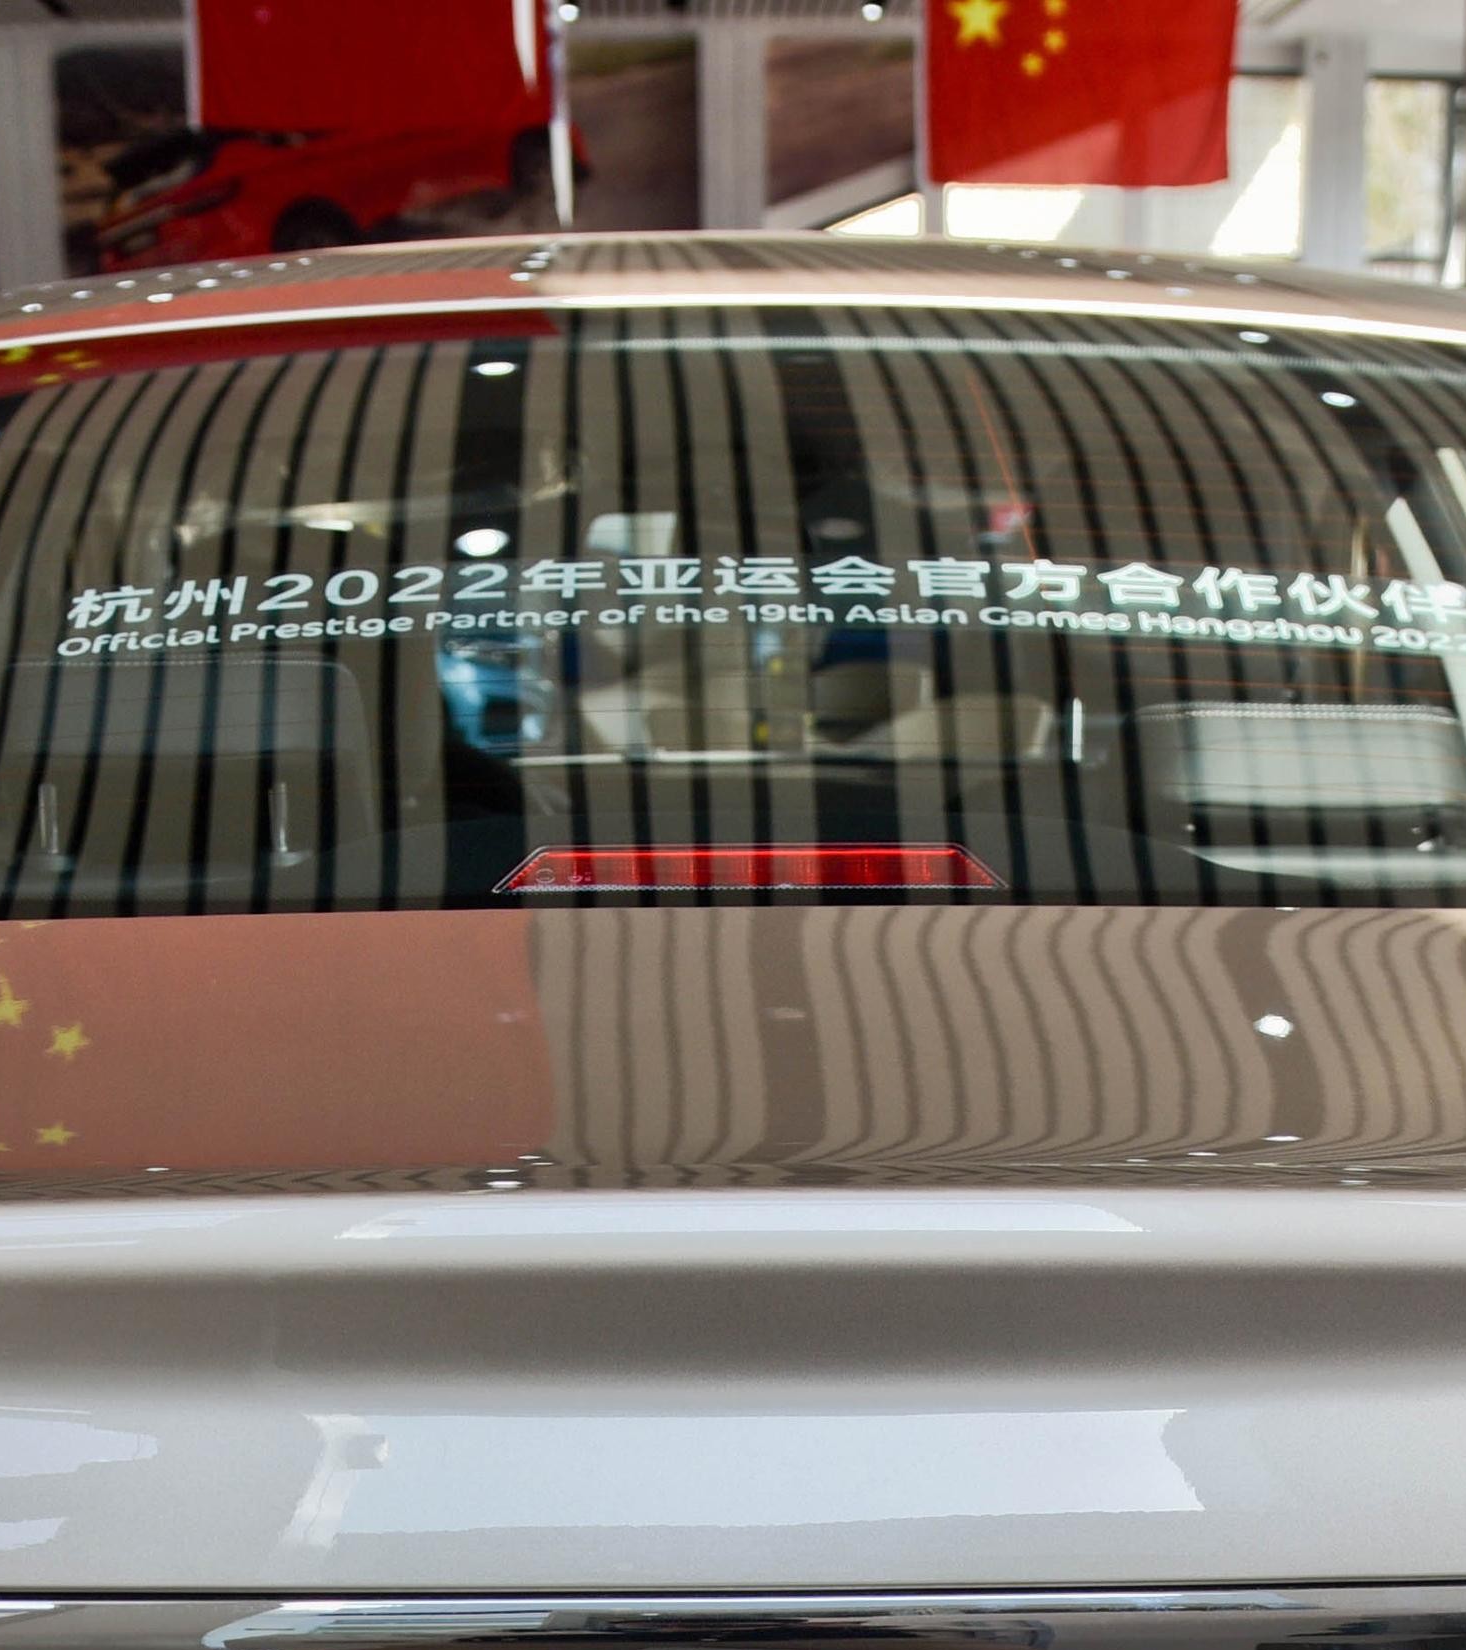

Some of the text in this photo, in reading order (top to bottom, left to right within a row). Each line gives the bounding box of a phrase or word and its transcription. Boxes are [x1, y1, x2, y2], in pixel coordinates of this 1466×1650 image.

[57, 622, 220, 657] Official
[230, 613, 414, 642] Prestige
[425, 607, 589, 631] Partner
[597, 604, 648, 624] of
[655, 603, 730, 623] the
[746, 603, 835, 623] 19th
[848, 603, 969, 625] Asian
[978, 606, 1131, 632] Games
[1138, 610, 1363, 646] Hangzhou
